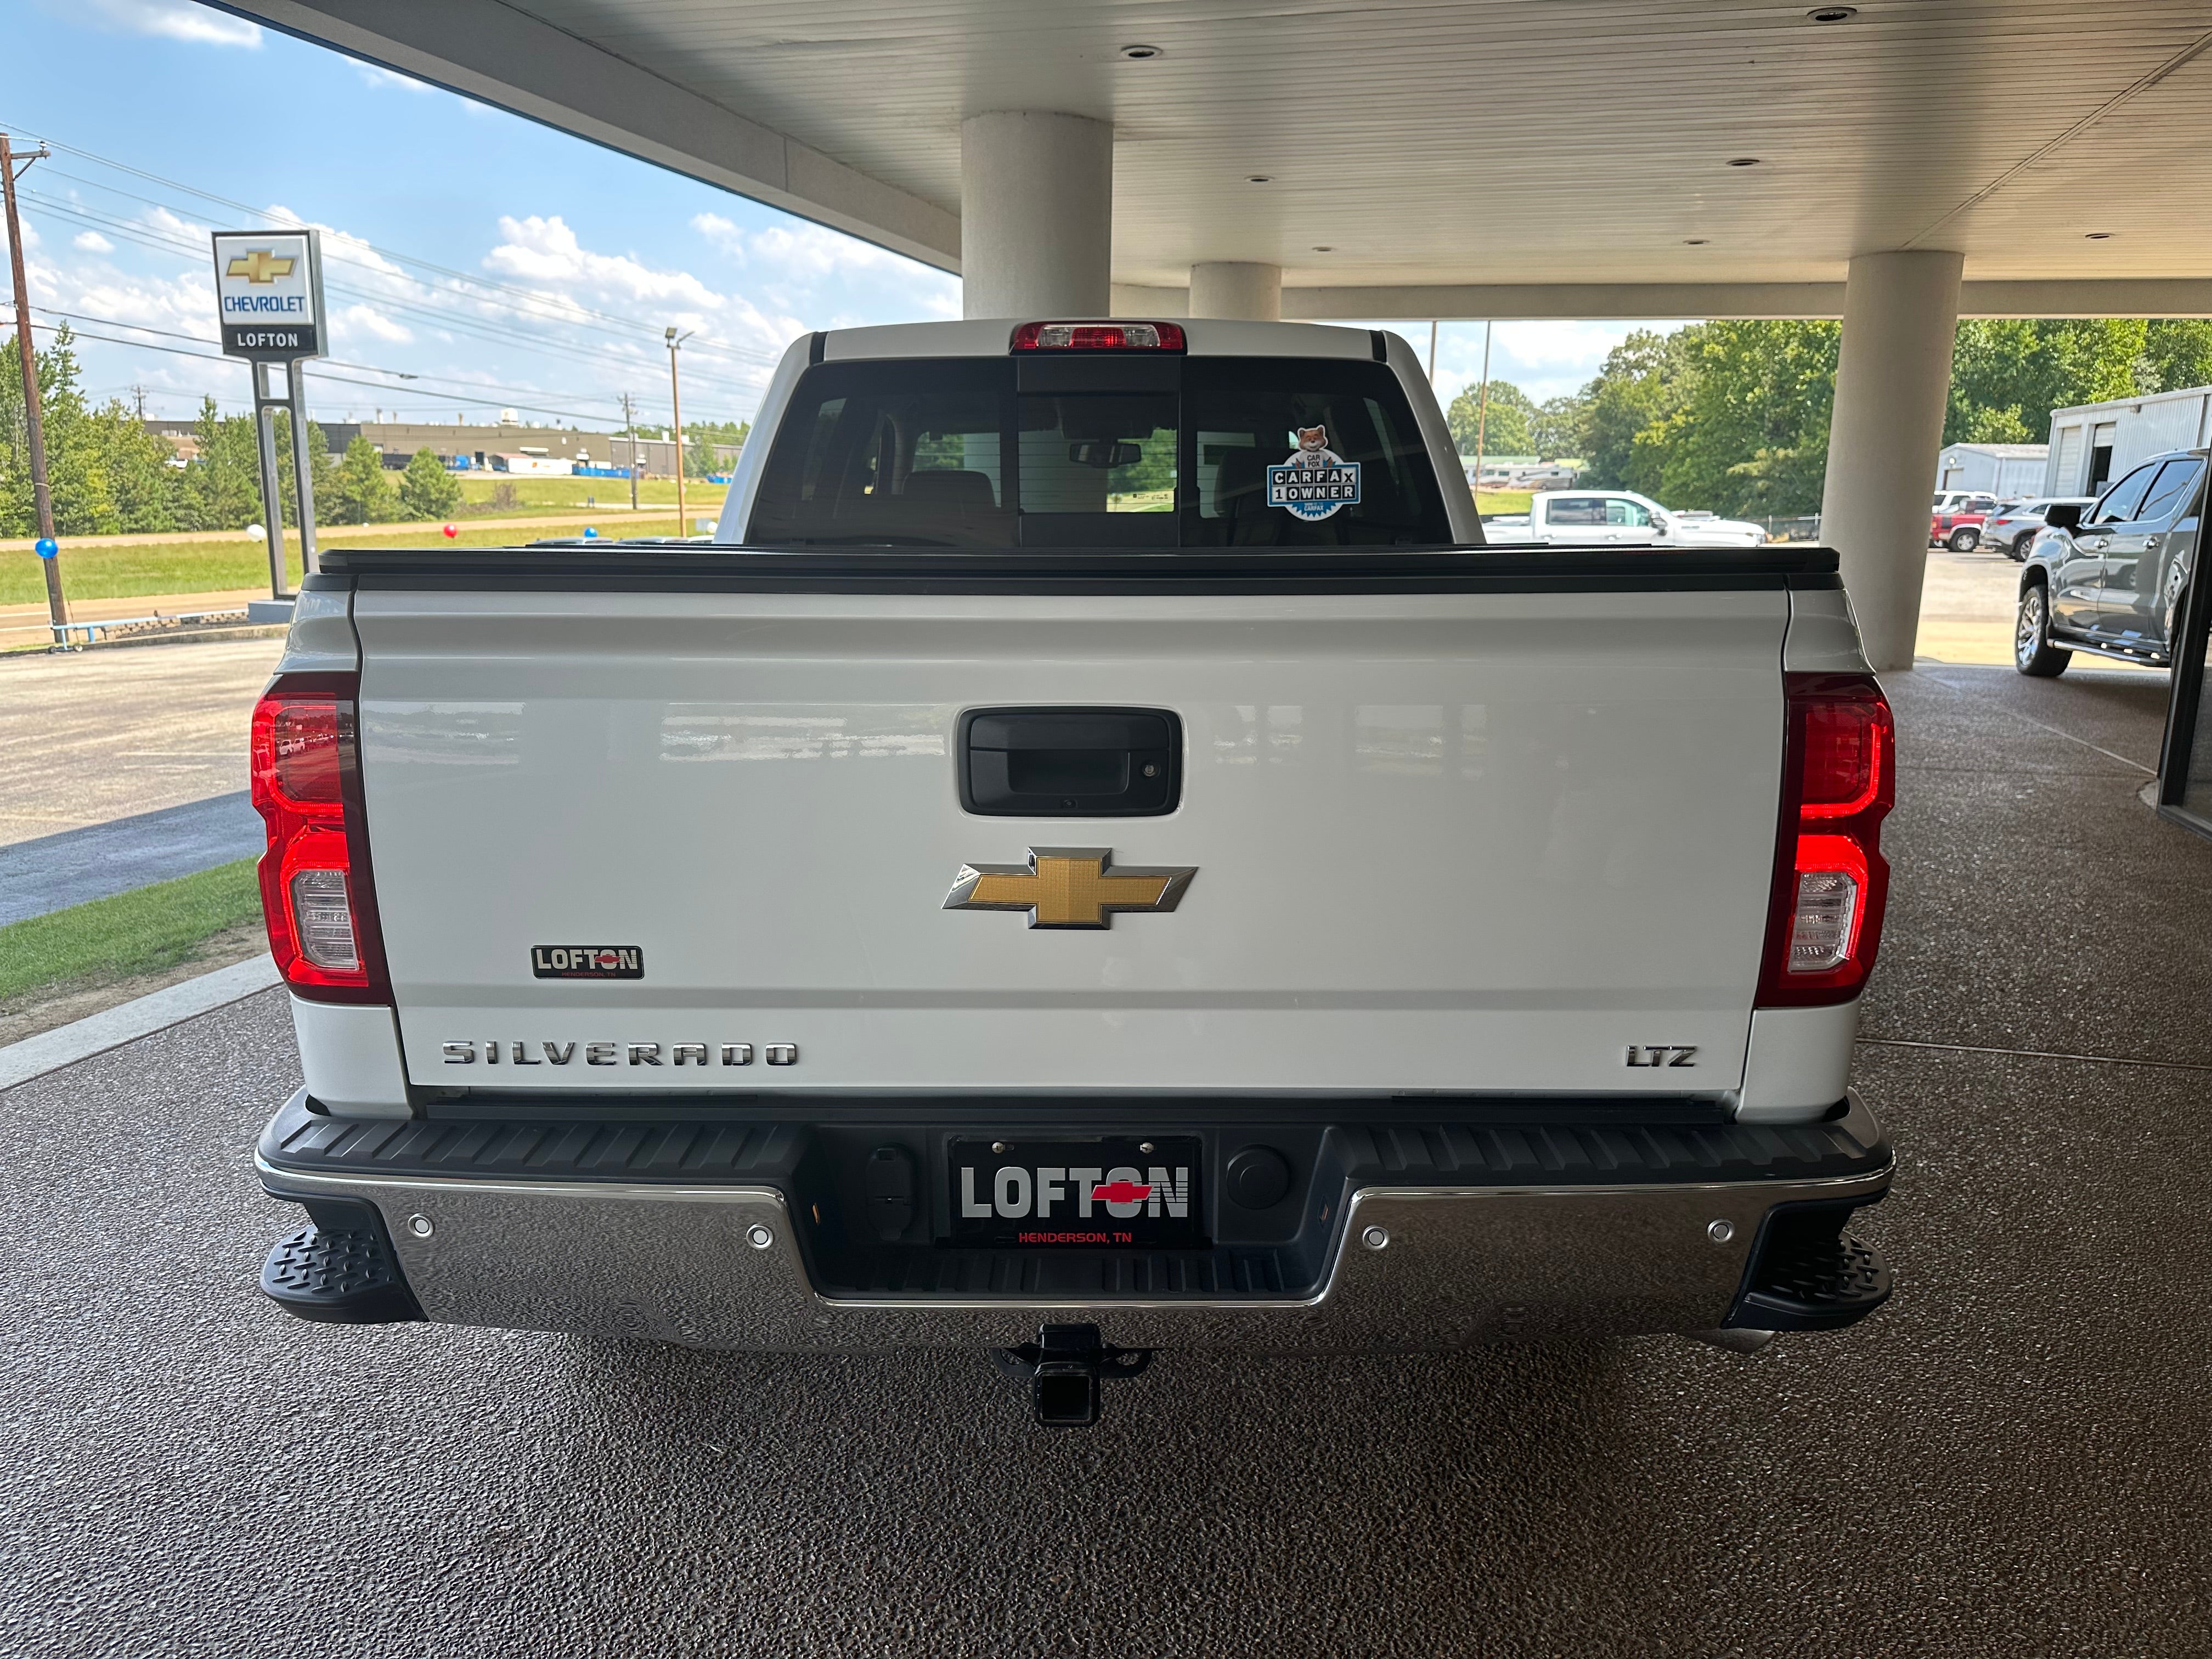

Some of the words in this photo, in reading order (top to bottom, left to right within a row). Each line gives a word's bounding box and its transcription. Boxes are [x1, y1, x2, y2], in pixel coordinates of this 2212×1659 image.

[224, 296, 305, 312] CHEVROLET
[237, 332, 298, 347] LOFTON
[1274, 470, 1353, 484] CARFAX
[1276, 489, 1283, 499] 1
[1288, 486, 1353, 500] OWNER
[536, 949, 638, 969] LOFTON
[443, 1040, 798, 1066] SILVERADO
[1626, 1046, 1697, 1067] LTZ
[961, 1166, 1188, 1218] LOFTON
[1019, 1232, 1110, 1244] HENDERSON,
[1113, 1232, 1132, 1243] TN
